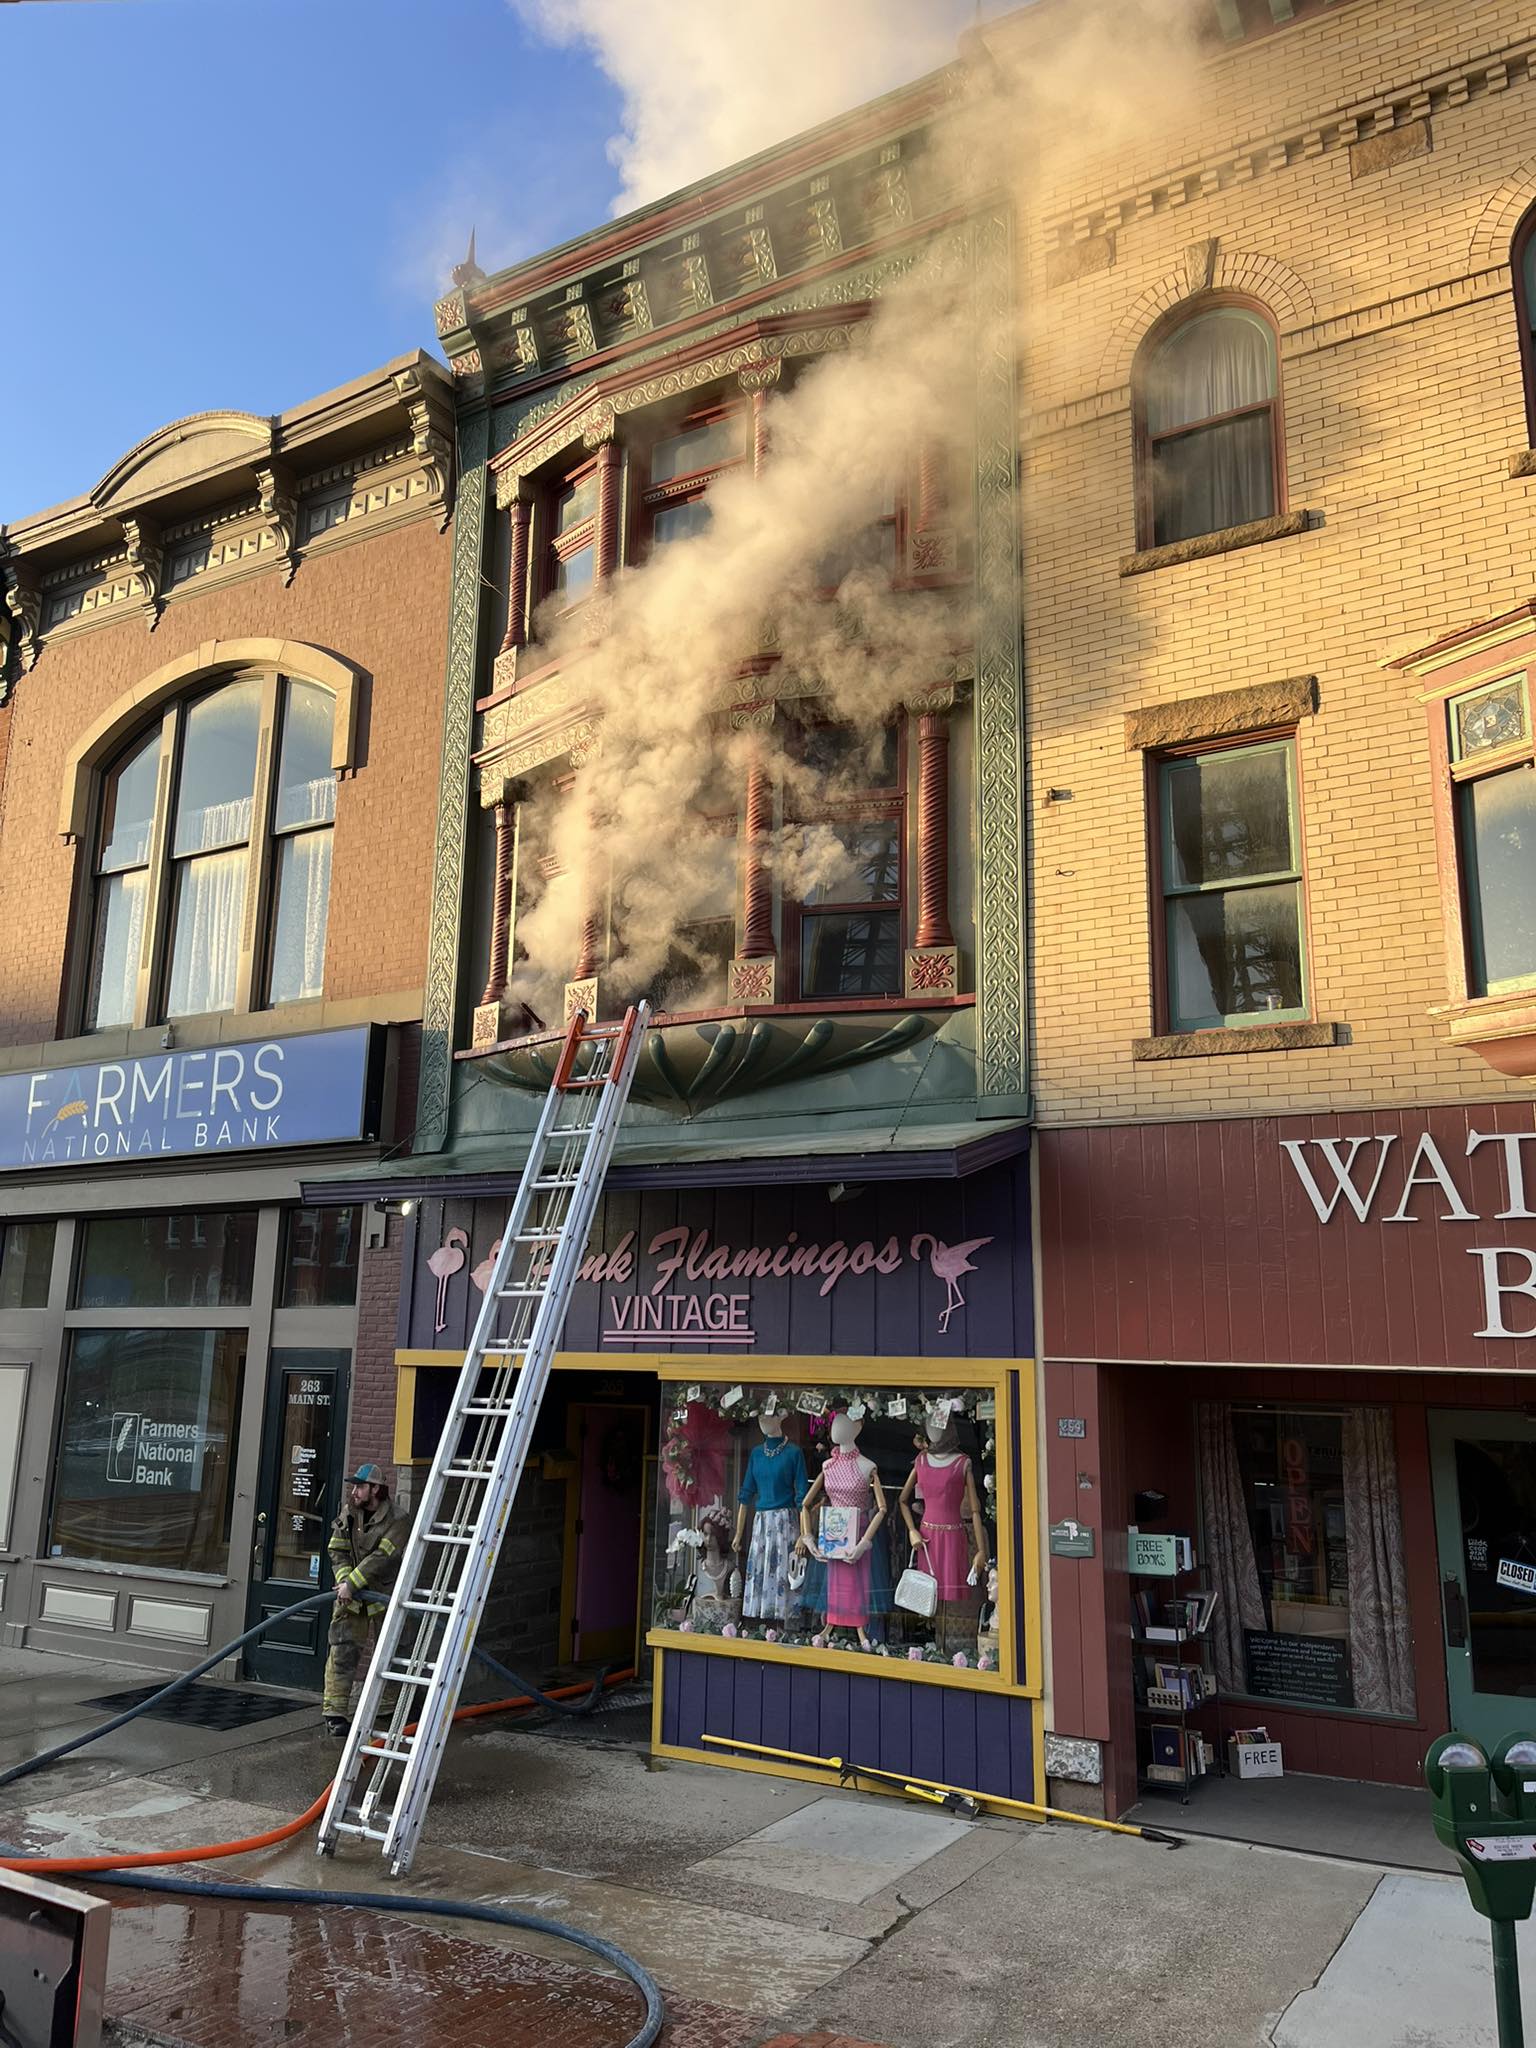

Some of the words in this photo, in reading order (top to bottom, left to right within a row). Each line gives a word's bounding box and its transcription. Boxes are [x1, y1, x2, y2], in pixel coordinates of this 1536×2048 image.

[25, 1043, 285, 1134] FARMERS
[22, 1126, 172, 1162] NATIONAL
[194, 1114, 281, 1148] BANK
[648, 1225, 903, 1296] Flamingos
[610, 1293, 750, 1331] VINTAGE
[300, 1379, 320, 1393] 263
[288, 1394, 315, 1405] MAIN
[316, 1394, 331, 1406] ST.
[141, 1418, 199, 1439] Farmers
[138, 1441, 198, 1463] National
[135, 1465, 173, 1486] Bank
[1285, 1439, 1315, 1553] OPEN
[1135, 1540, 1163, 1552] FREE
[1137, 1553, 1166, 1566] BOOKS
[1500, 1561, 1535, 1583] CLOSED
[1244, 1750, 1277, 1766] FREE
